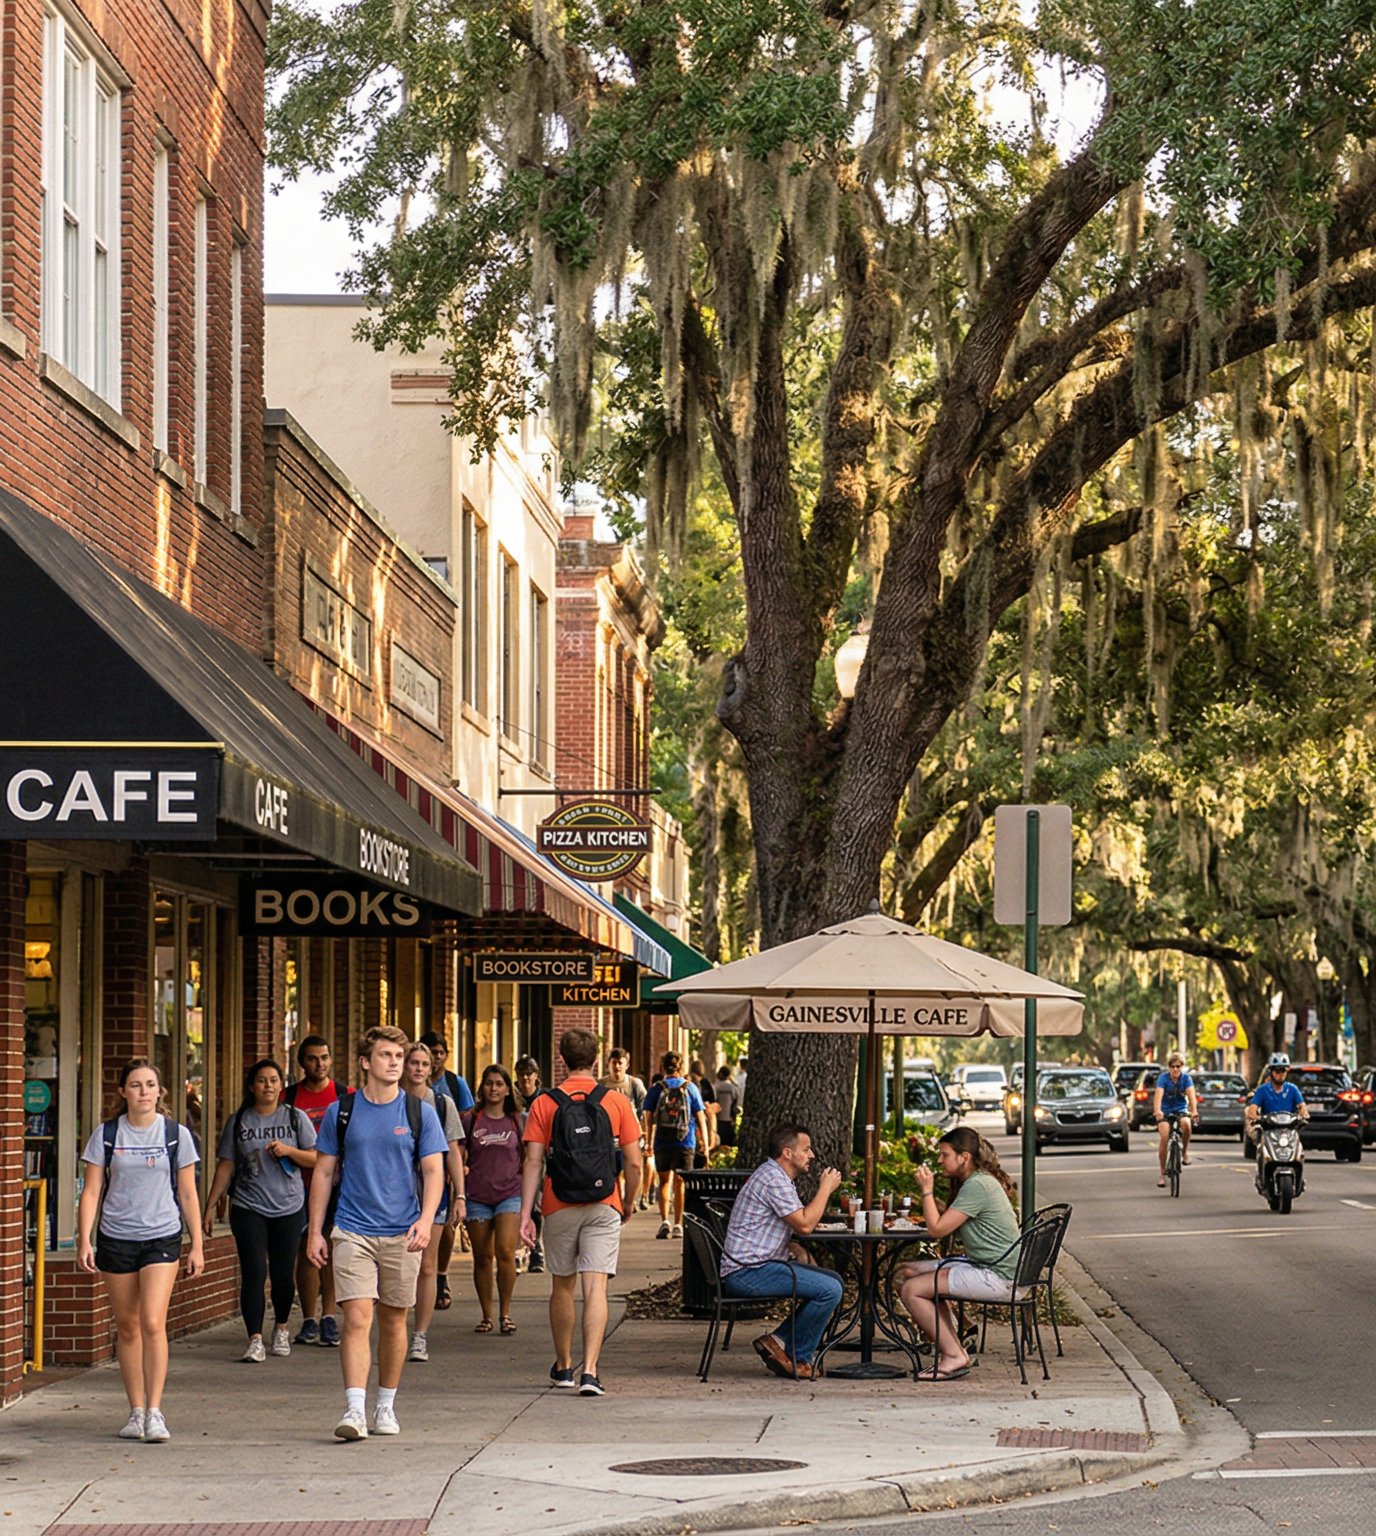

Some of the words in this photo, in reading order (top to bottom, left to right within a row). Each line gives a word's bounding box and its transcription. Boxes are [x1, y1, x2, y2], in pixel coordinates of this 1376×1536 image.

[6, 769, 198, 823] CAFE
[255, 778, 289, 836] CAFE
[543, 831, 583, 846] PIZZA
[587, 831, 647, 846] KITCHEN
[359, 827, 411, 887] BOOKSTORE
[254, 888, 420, 926] BOOKS
[482, 960, 587, 976] BOOKSTORE
[563, 988, 631, 1002] KITCHEN
[913, 1007, 969, 1026] CAFE
